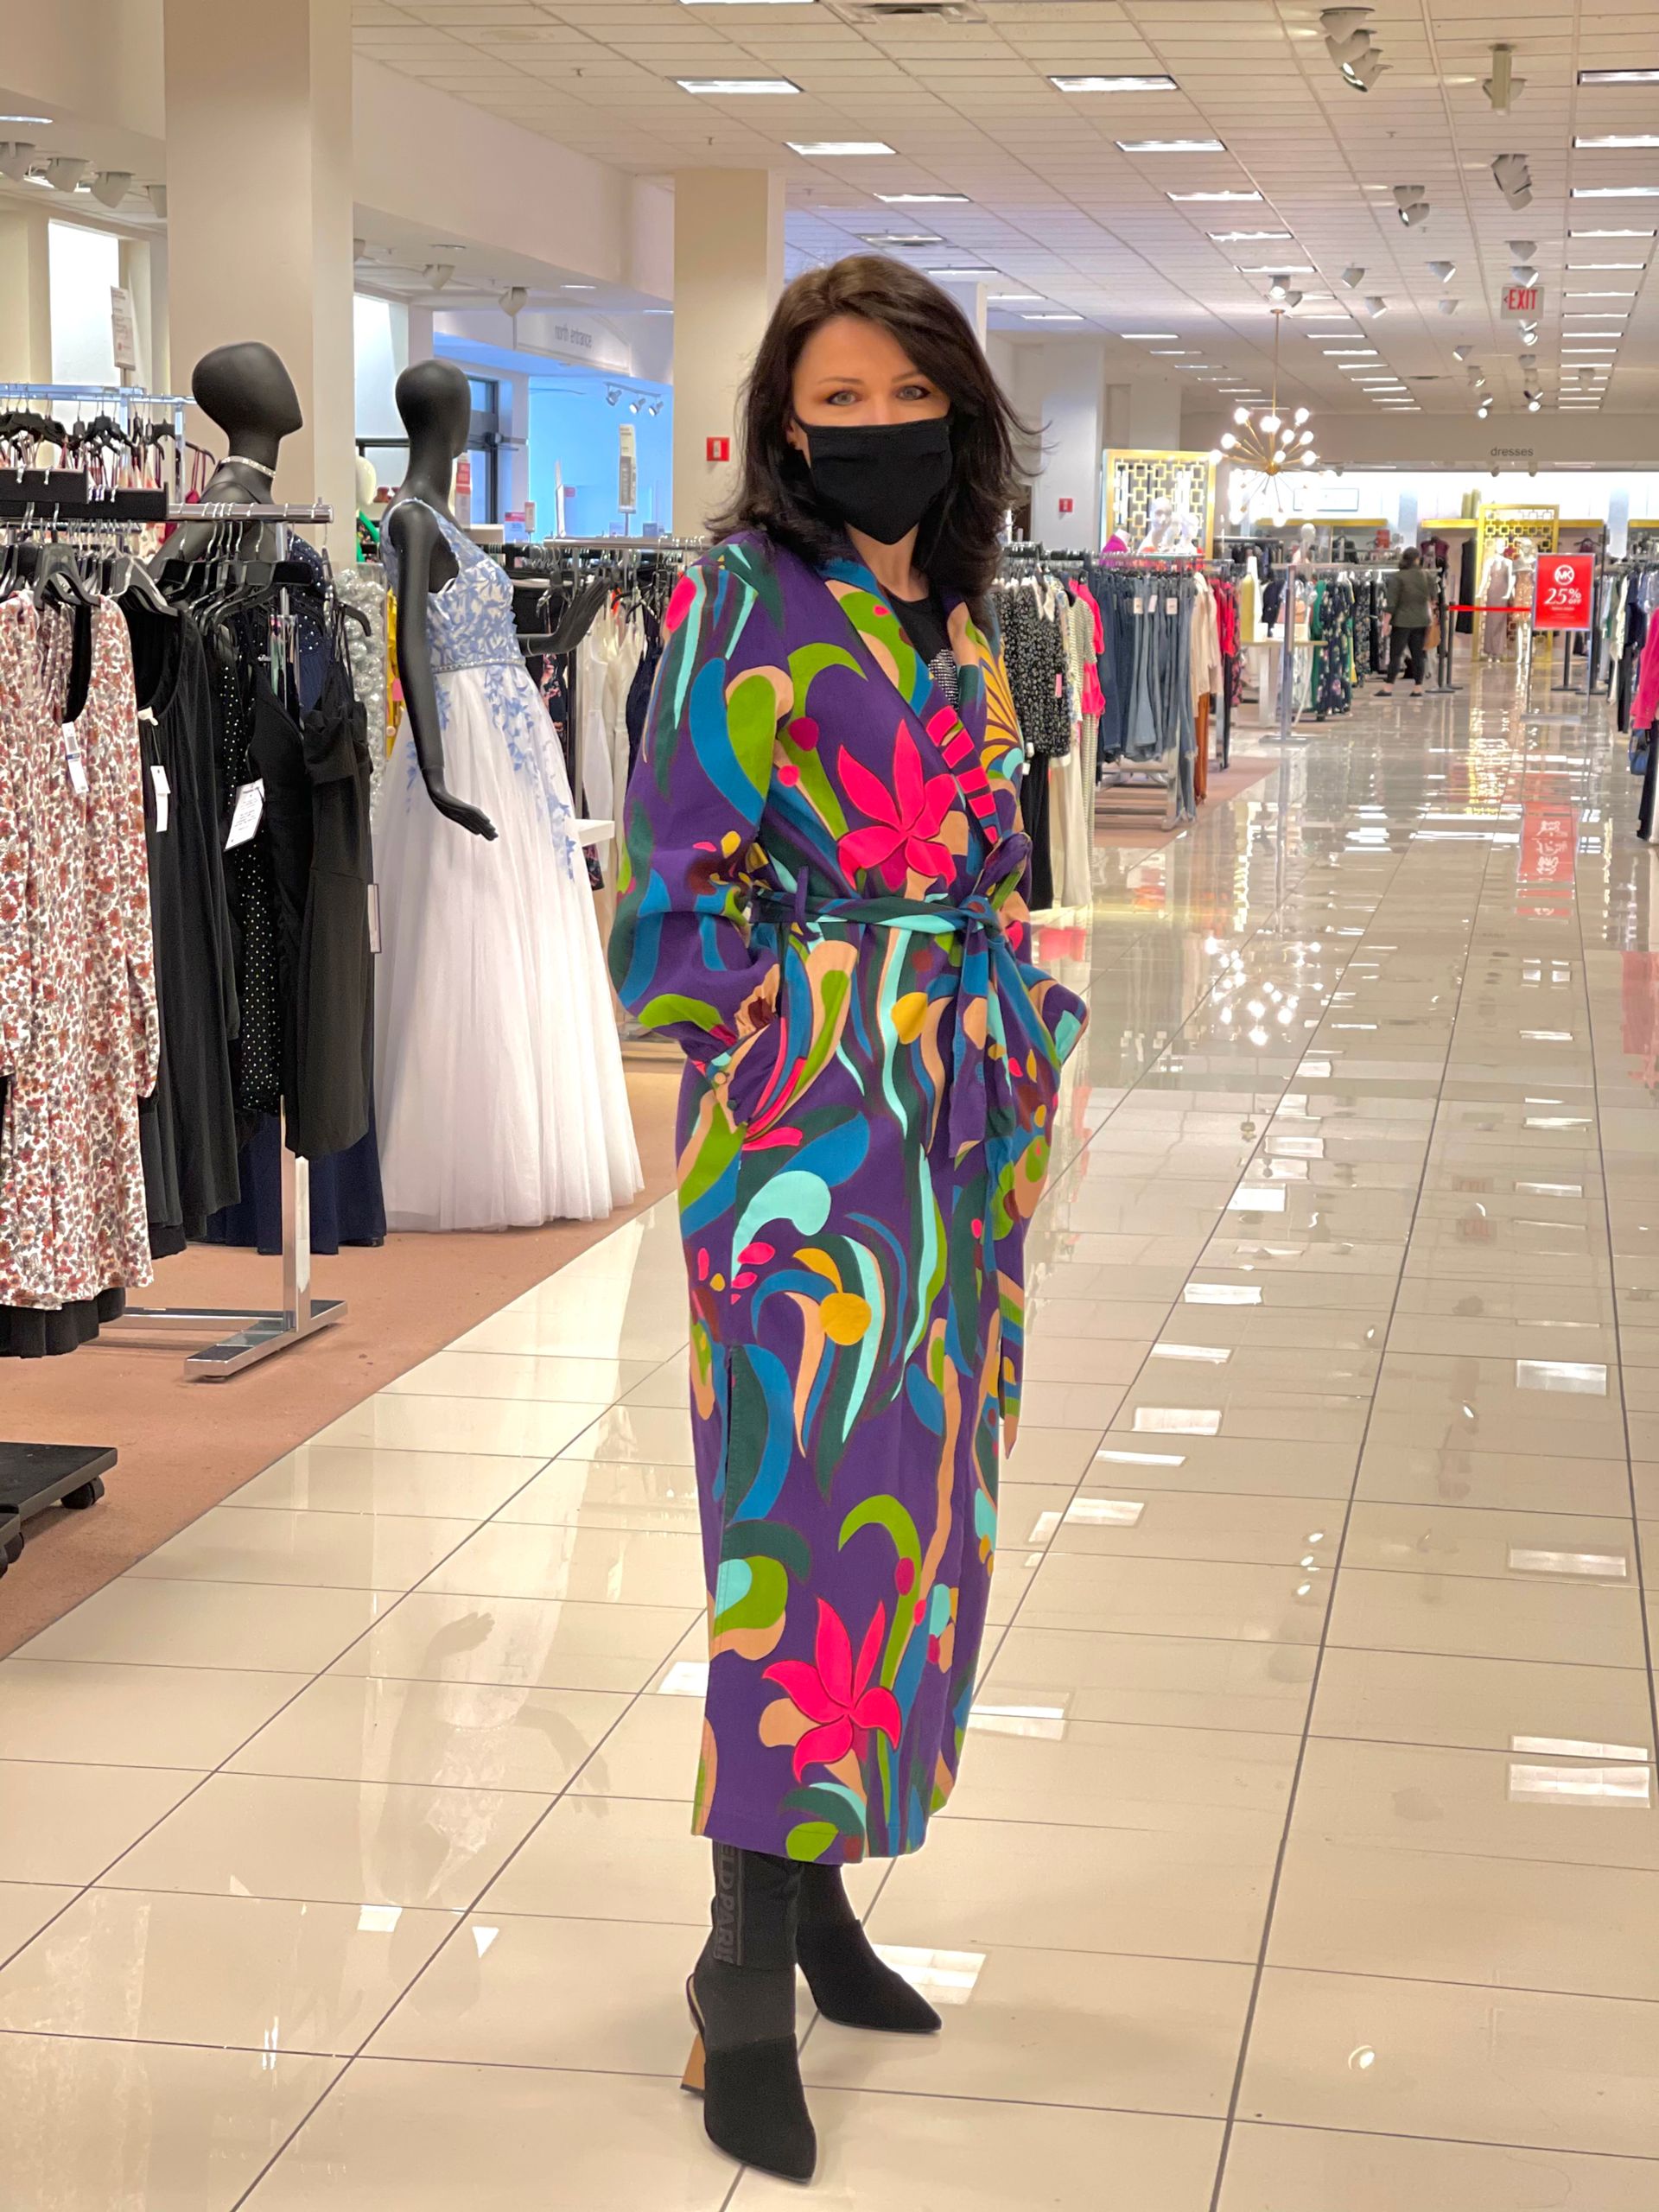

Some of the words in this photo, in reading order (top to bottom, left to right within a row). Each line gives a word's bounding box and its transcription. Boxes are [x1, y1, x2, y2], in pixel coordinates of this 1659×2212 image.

[1509, 289, 1538, 310] EXIT
[1490, 446, 1535, 456] dresses
[1554, 567, 1575, 583] MK
